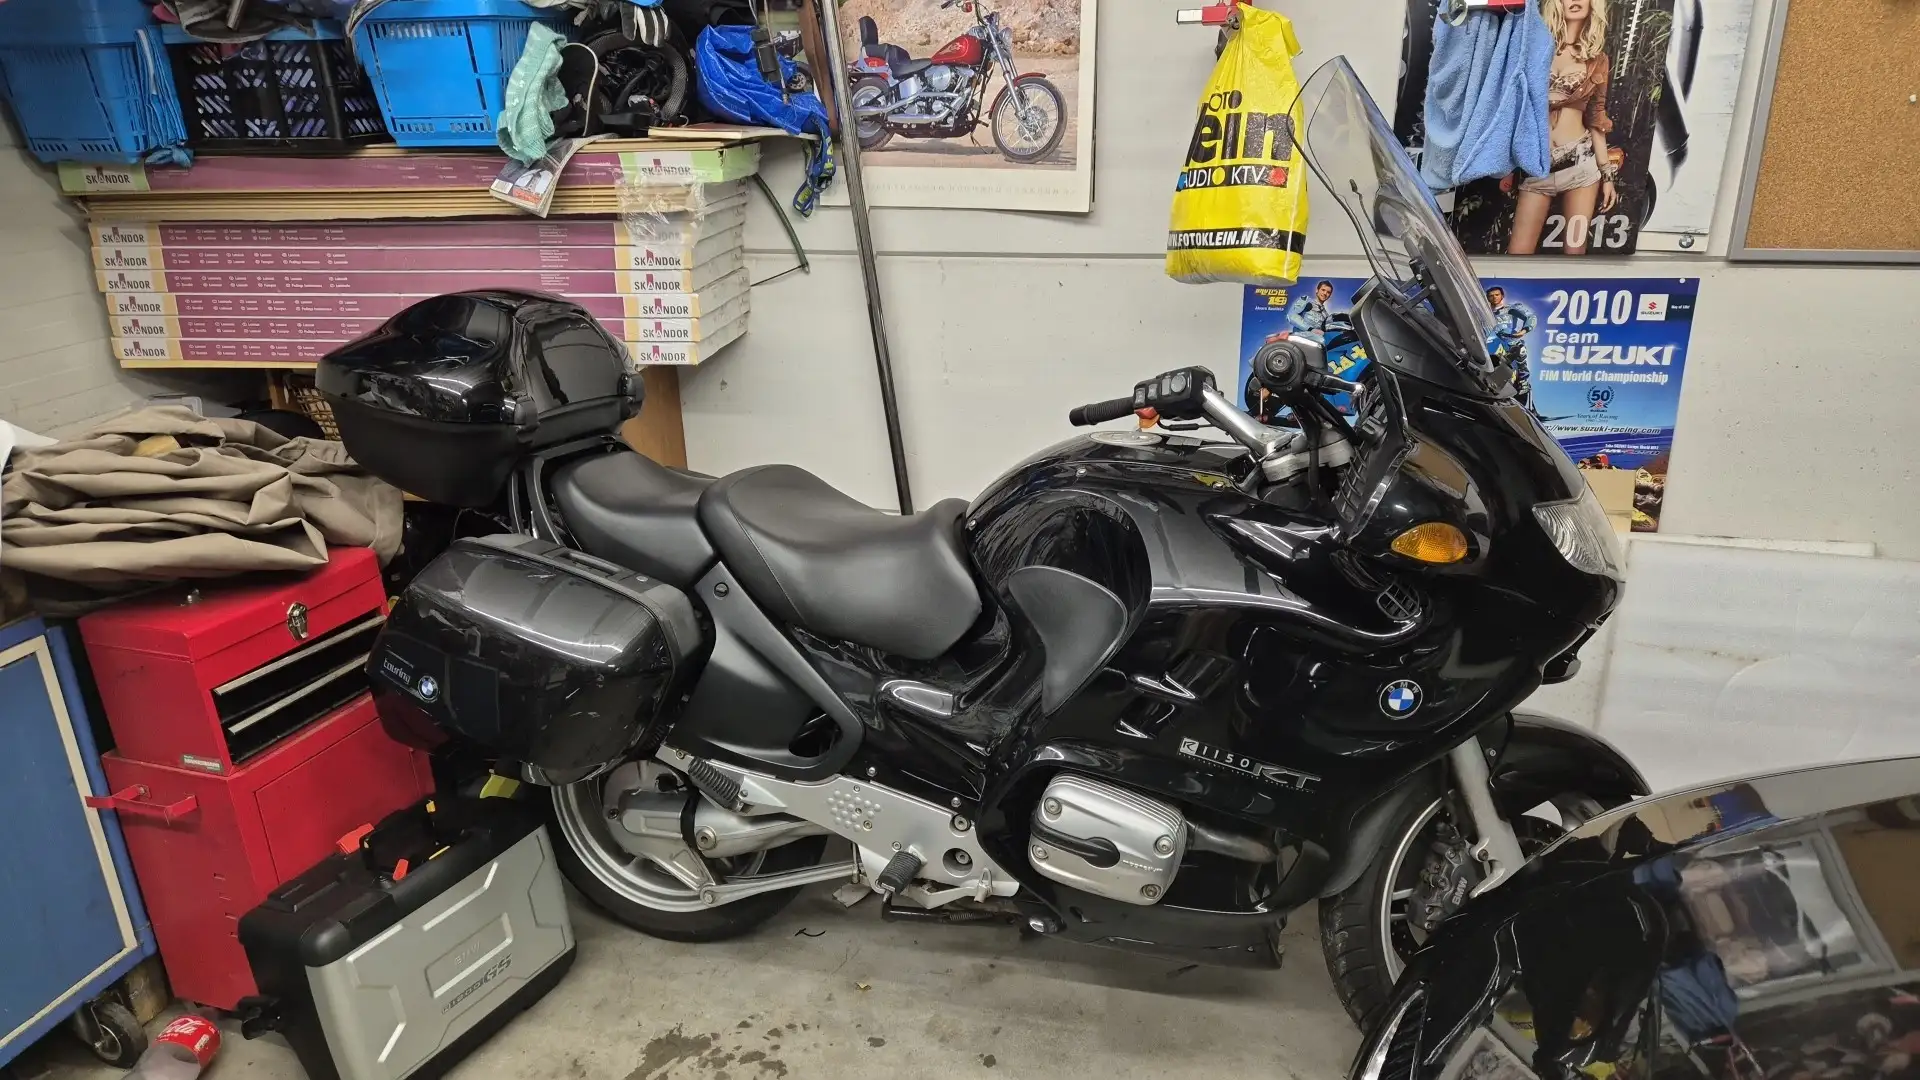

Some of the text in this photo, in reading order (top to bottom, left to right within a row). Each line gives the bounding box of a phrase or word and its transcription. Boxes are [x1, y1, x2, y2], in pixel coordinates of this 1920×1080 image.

[1208, 89, 1242, 112] OTO
[86, 171, 131, 184] SKANDOR
[1230, 165, 1267, 185] KTV
[102, 231, 145, 243] SKANDOR
[1542, 214, 1630, 248] 2013
[105, 255, 148, 267] SKANDOR
[634, 254, 681, 266] SKANDOR
[108, 278, 151, 290] SKANDOR
[634, 279, 681, 291] SKANDOR
[119, 301, 162, 312] SKANDOR
[642, 303, 689, 315] SKANDOR
[1547, 289, 1633, 325] 2010
[122, 323, 165, 335] SKANDOR
[642, 327, 689, 338] SKANDOR
[1545, 329, 1599, 344] Team
[124, 346, 166, 357] SKANDOR
[640, 350, 686, 361] SKANDOR
[1540, 345, 1674, 366] SUZUKI
[1539, 370, 1669, 385] FIM World Championship
[1591, 389, 1611, 401] 50
[1451, 876, 1468, 906] BMW
